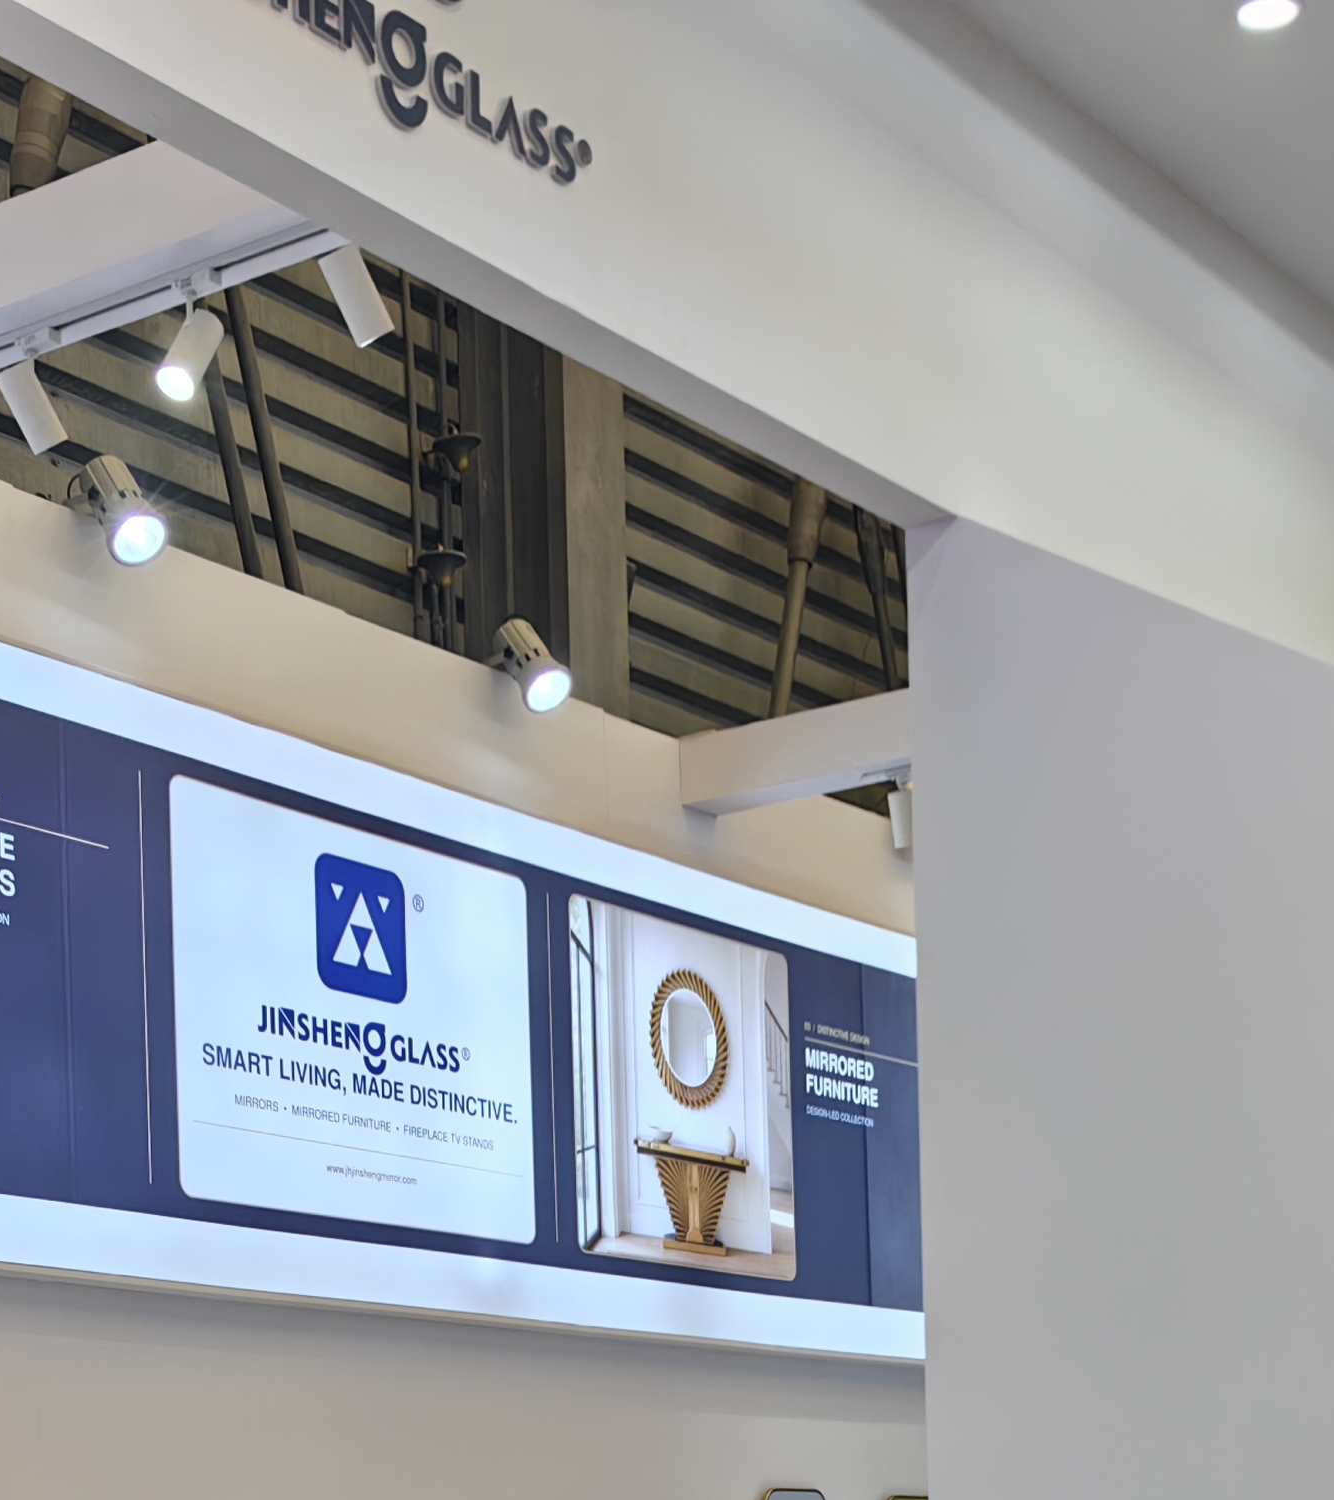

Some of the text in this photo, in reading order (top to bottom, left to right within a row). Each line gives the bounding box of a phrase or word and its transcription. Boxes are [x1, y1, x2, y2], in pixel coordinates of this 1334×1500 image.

[804, 1047, 875, 1083] MIRRORED
[202, 1042, 518, 1125] SMART LIVING, MADE DISTINCTIVE.
[805, 1073, 880, 1109] FURNITURE
[234, 1093, 494, 1151] MIRRORS MIRRORED FURNITURE FIREPLACE TV STANDS
[806, 1104, 875, 1128] DESIGN-LED COLLECTION
